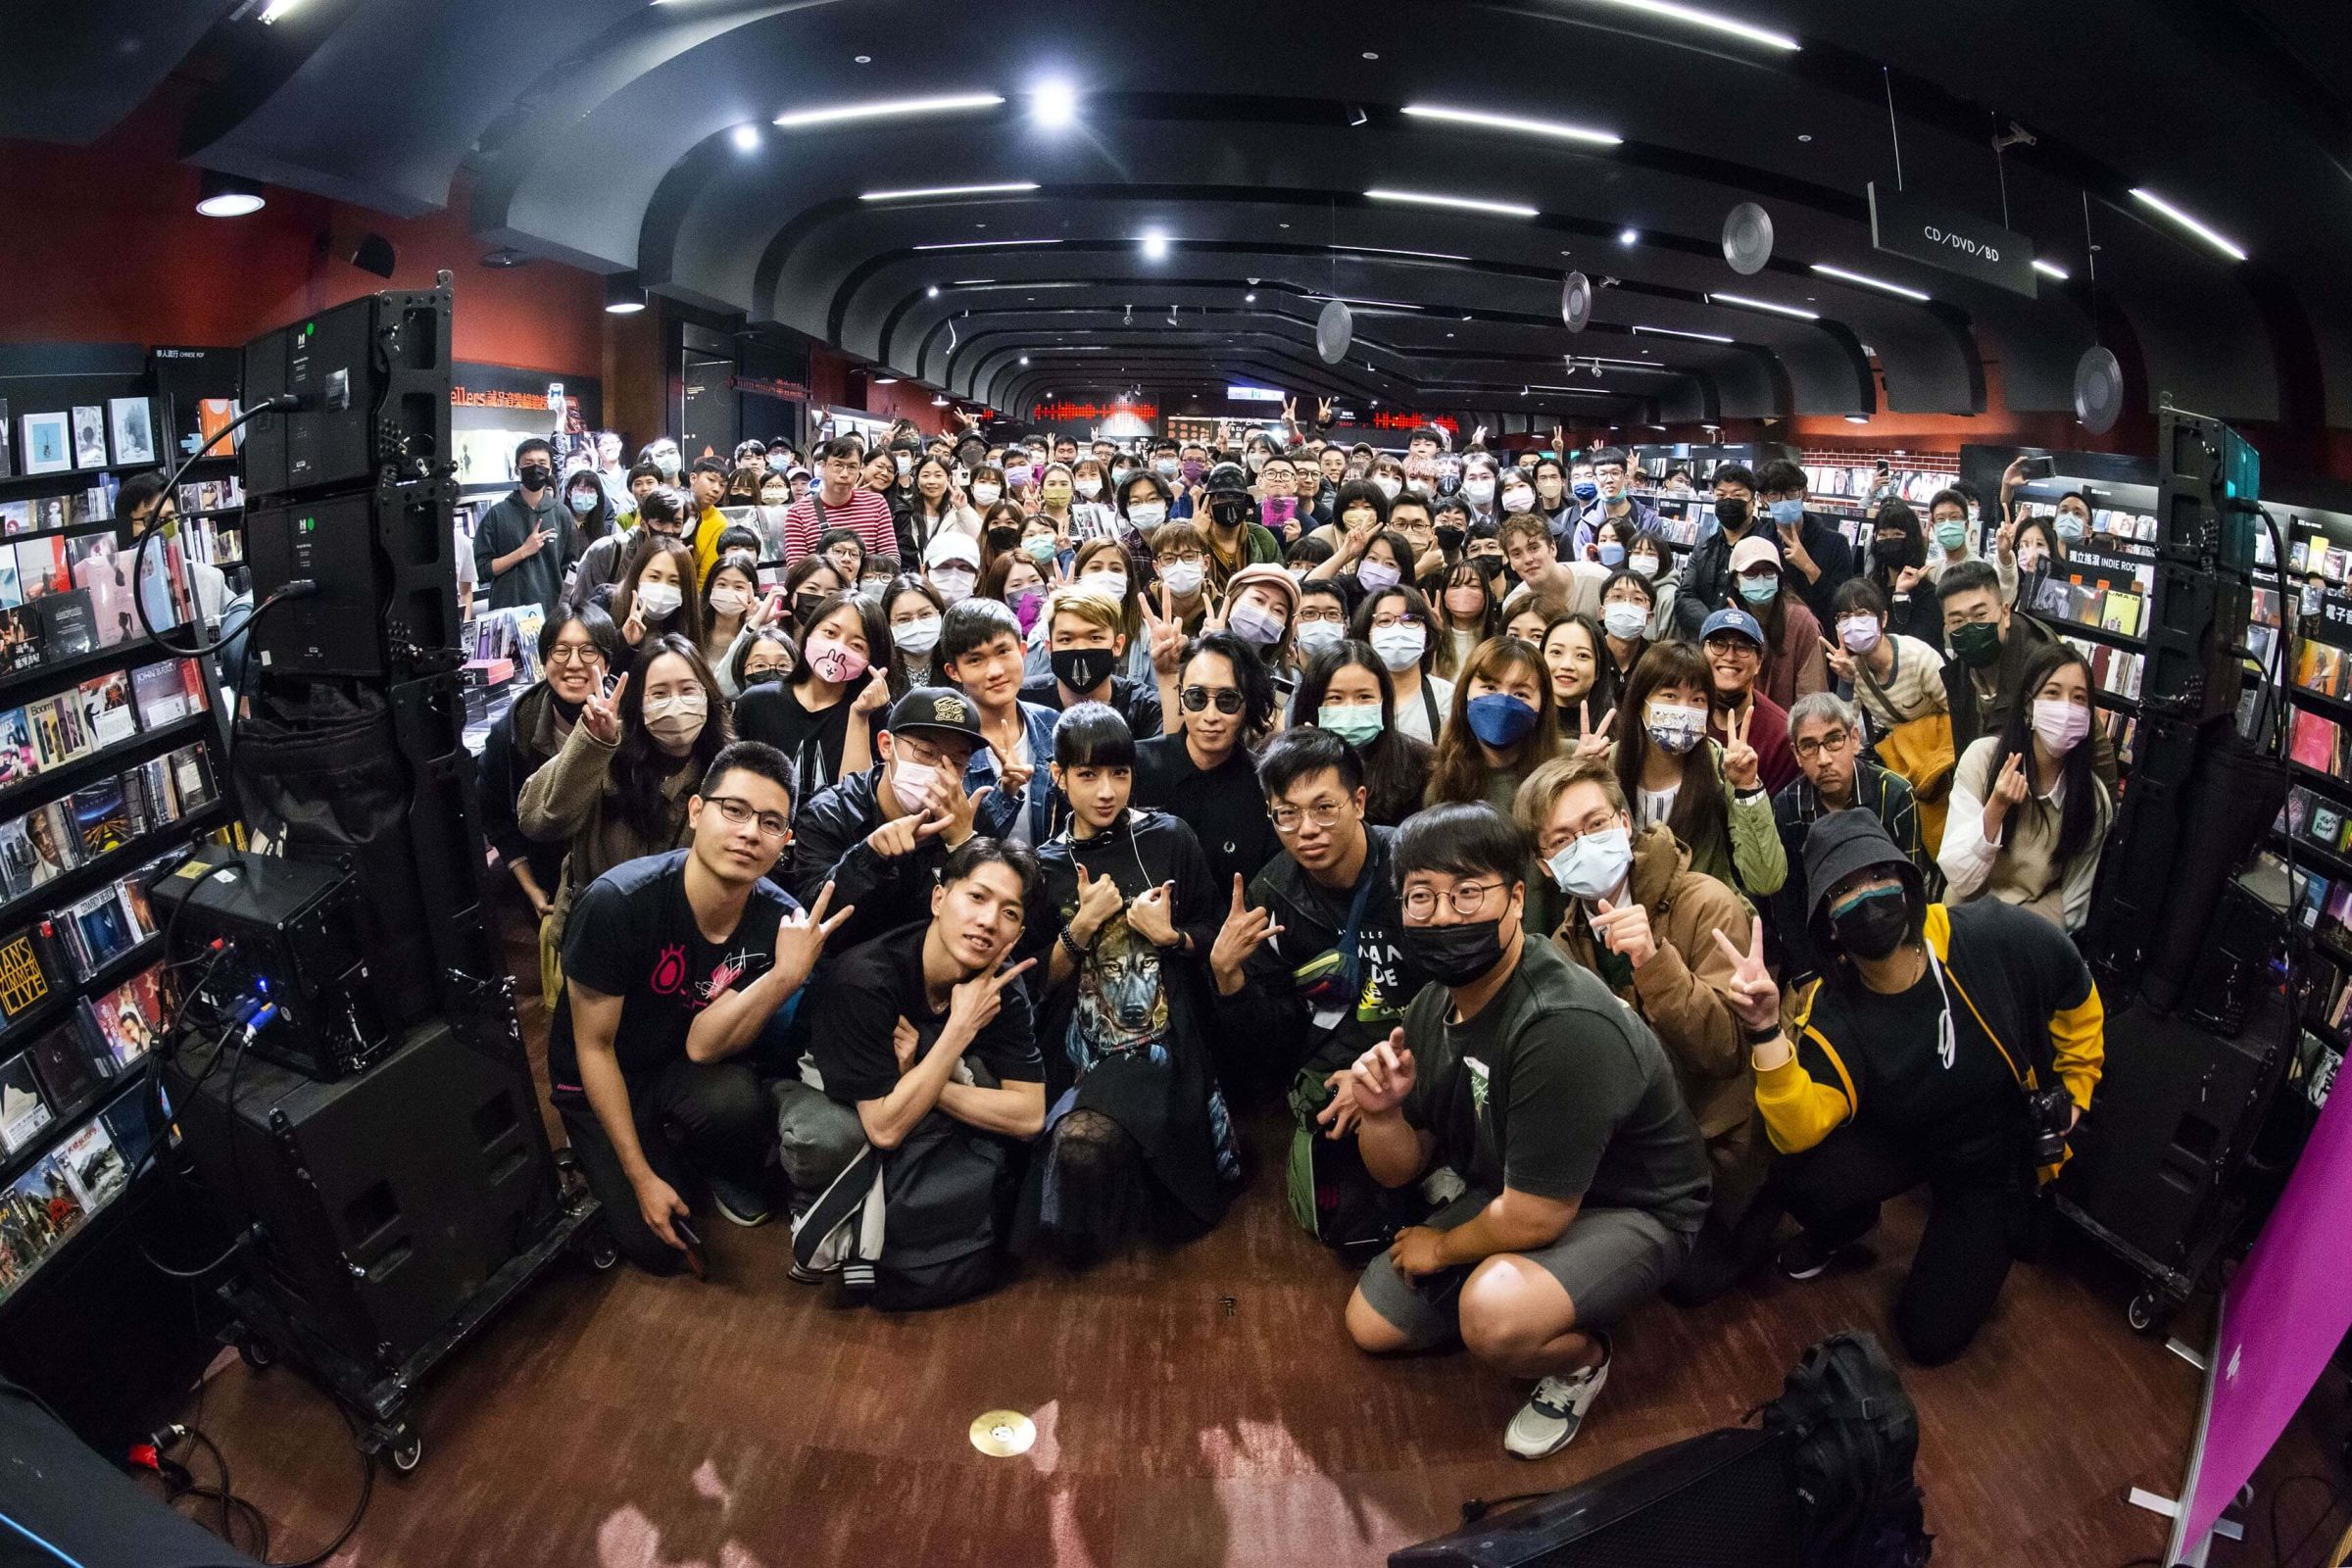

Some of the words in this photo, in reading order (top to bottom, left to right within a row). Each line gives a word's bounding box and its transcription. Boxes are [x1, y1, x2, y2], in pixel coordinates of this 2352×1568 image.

[1924, 225, 1999, 262] CD/DVD/BD
[451, 386, 485, 406] ellers
[2101, 558, 2121, 569] INDIE
[2121, 562, 2135, 572] ROC
[4, 974, 48, 1012] LIVE
